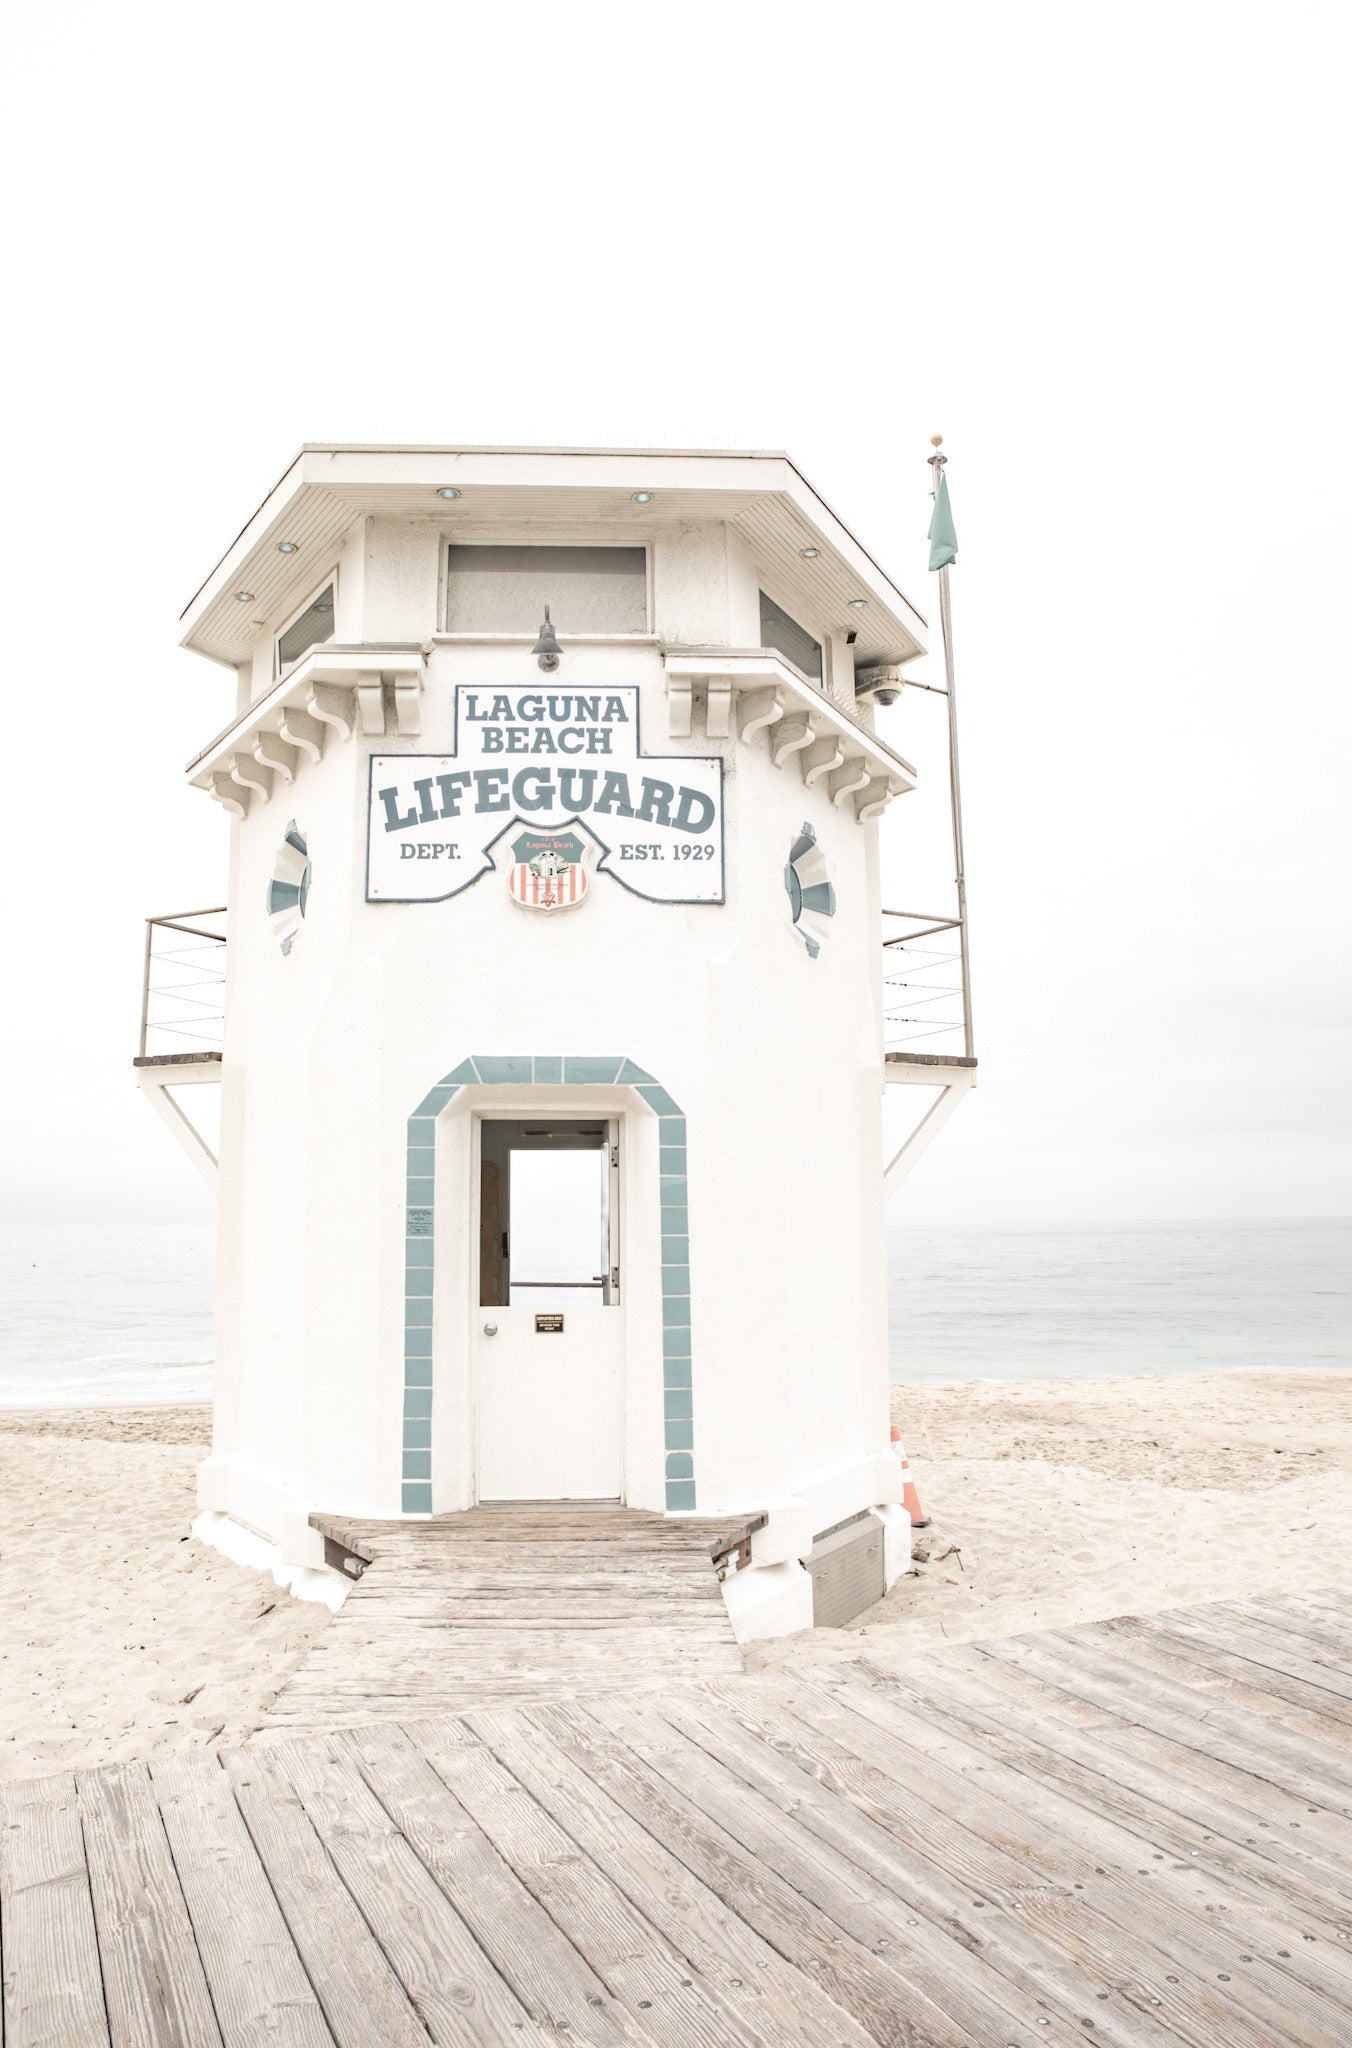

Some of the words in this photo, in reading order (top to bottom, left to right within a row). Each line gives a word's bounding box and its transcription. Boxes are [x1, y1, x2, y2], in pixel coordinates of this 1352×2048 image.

[466, 695, 628, 722] LAGUNA
[482, 727, 612, 754] BEACH
[379, 767, 715, 834] LIFEGUARD
[400, 843, 461, 859] DEPT.
[620, 845, 665, 860] EST.
[673, 845, 715, 860] 1929
